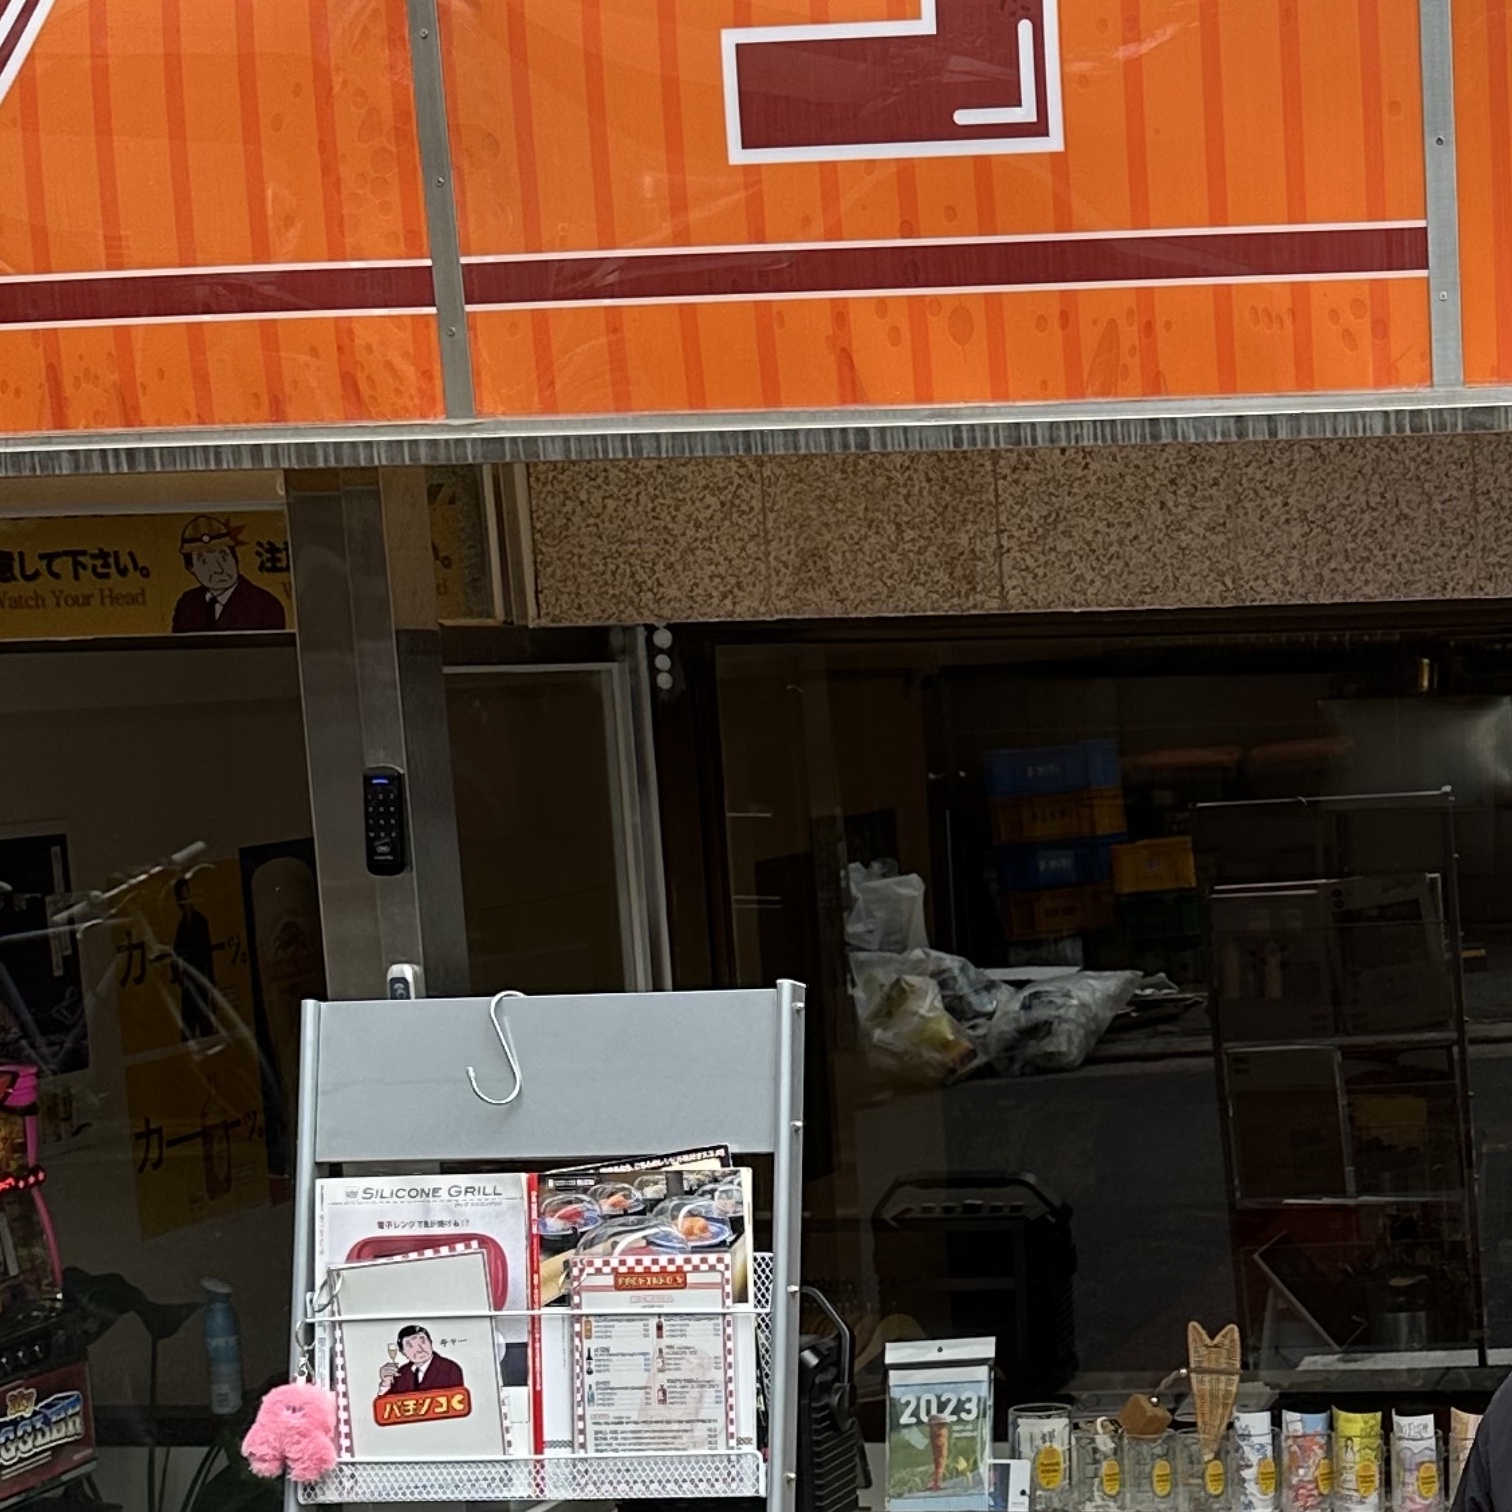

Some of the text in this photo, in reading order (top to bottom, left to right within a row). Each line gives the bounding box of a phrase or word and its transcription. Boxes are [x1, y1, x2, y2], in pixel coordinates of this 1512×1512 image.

[50, 589, 93, 608] Your
[98, 586, 146, 607] Head
[361, 1184, 503, 1200] SILICONE GRILL
[899, 1391, 979, 1425] 2023
